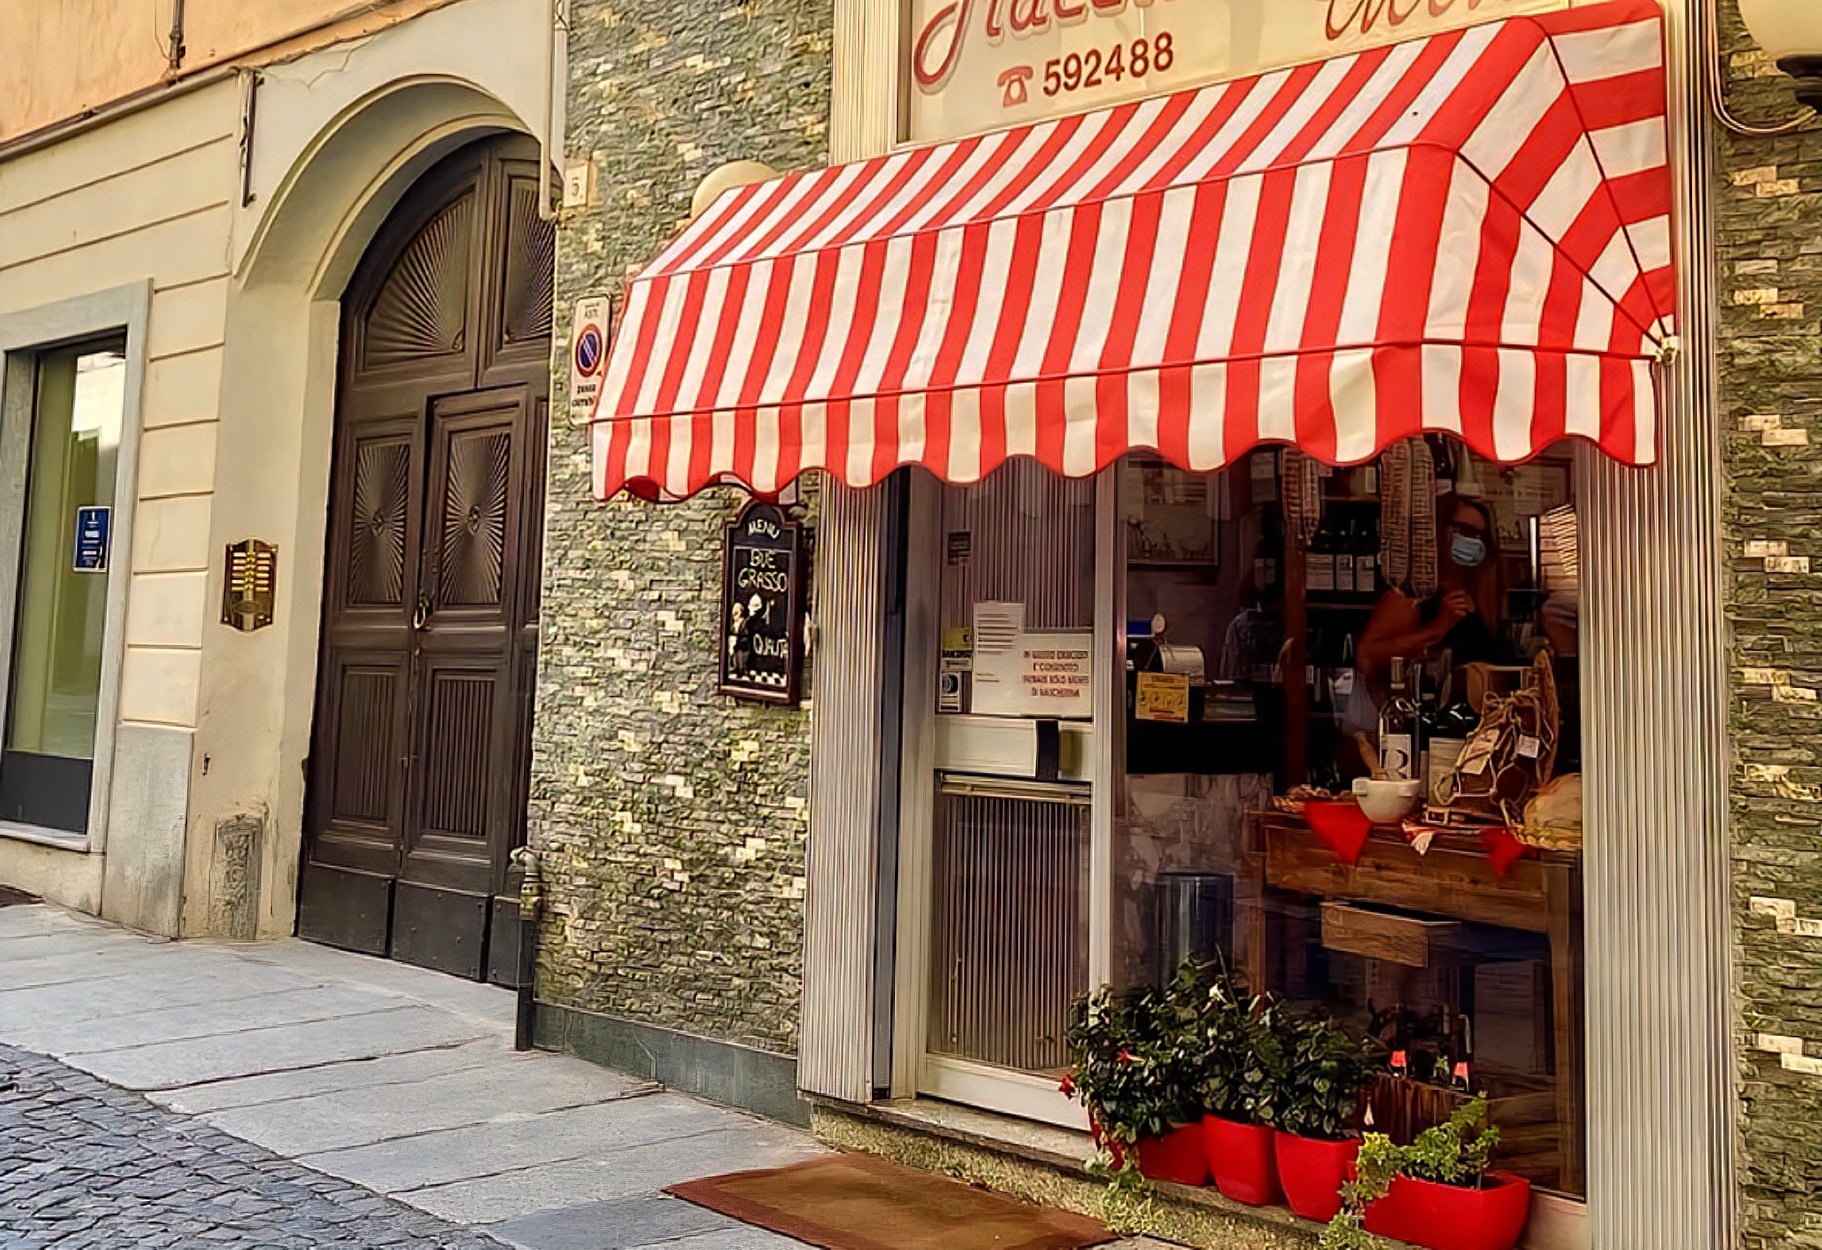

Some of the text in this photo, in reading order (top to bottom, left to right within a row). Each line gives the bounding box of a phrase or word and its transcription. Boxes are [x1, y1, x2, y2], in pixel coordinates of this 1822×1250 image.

[1042, 31, 1175, 97] 592488
[747, 518, 781, 540] MENU
[737, 566, 788, 593] GRASSO
